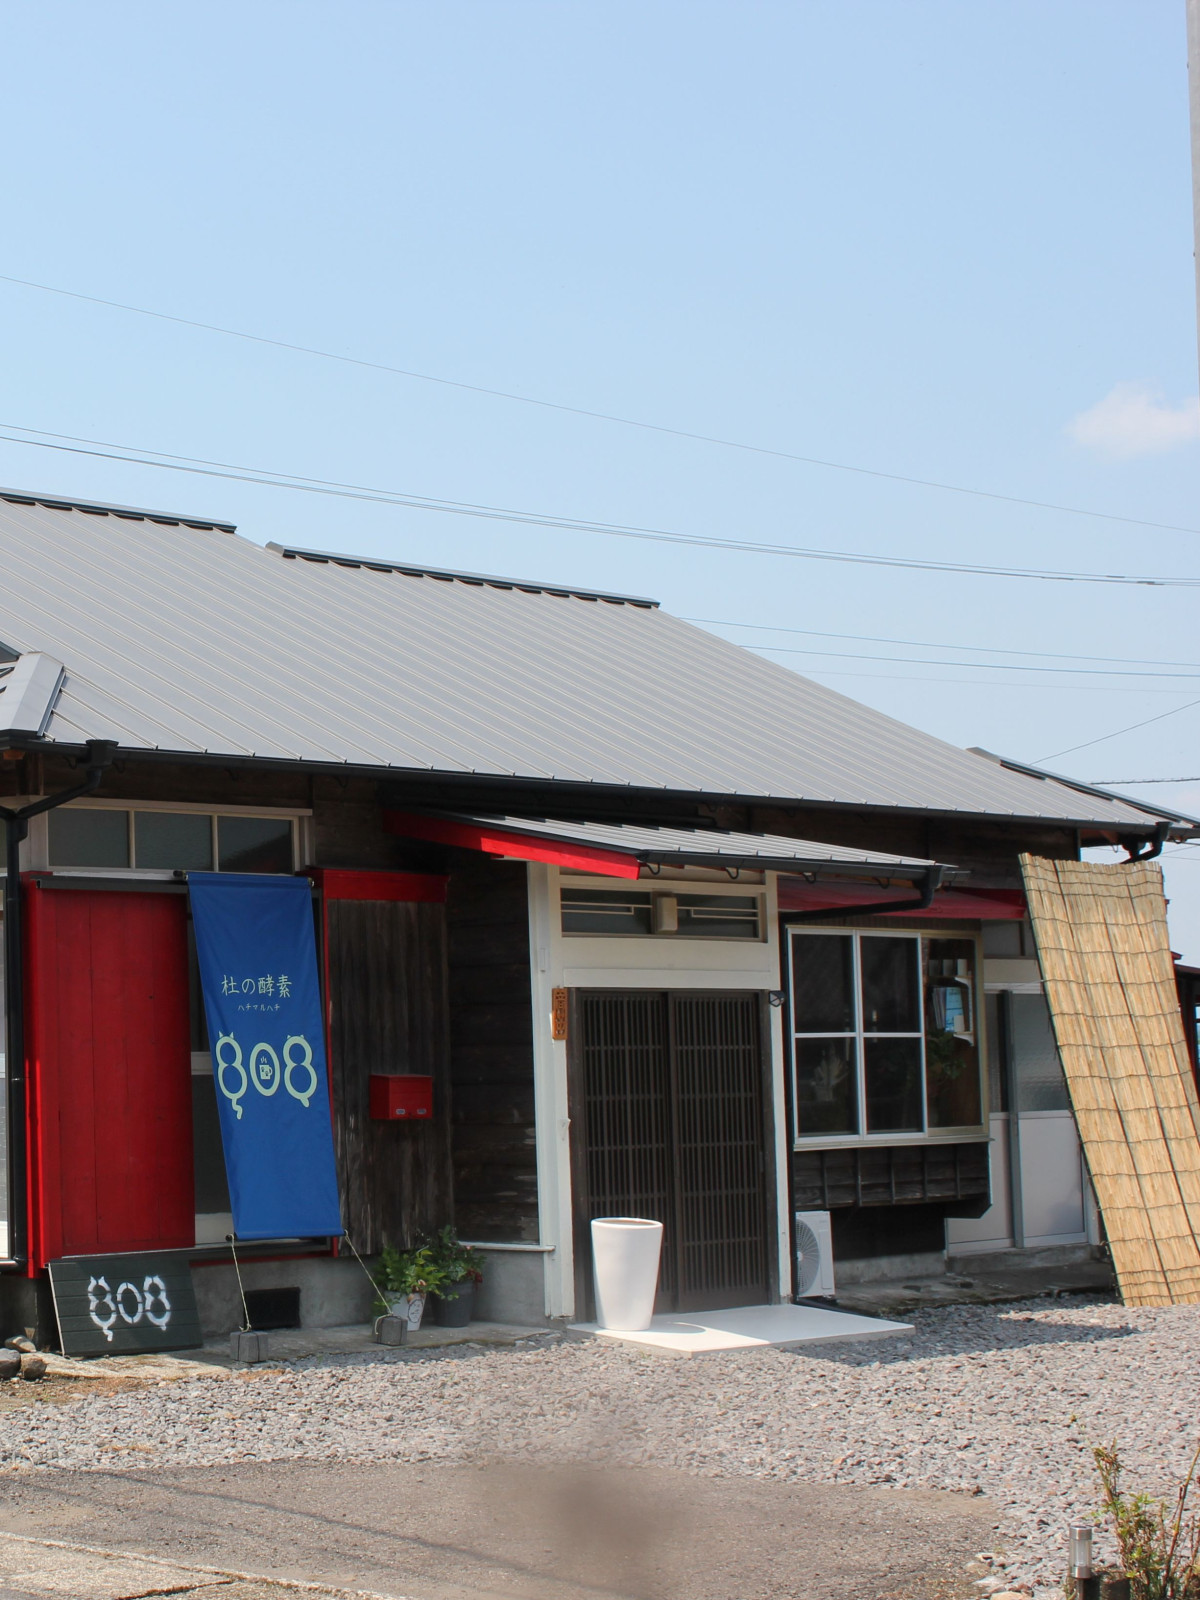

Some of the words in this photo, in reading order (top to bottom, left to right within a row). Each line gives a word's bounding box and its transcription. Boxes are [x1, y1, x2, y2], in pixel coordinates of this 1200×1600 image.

[221, 974, 292, 998] 杜の酵素
[237, 1003, 280, 1012] ハチマルハチ
[215, 1031, 317, 1120] 808
[87, 1275, 171, 1342] 808
